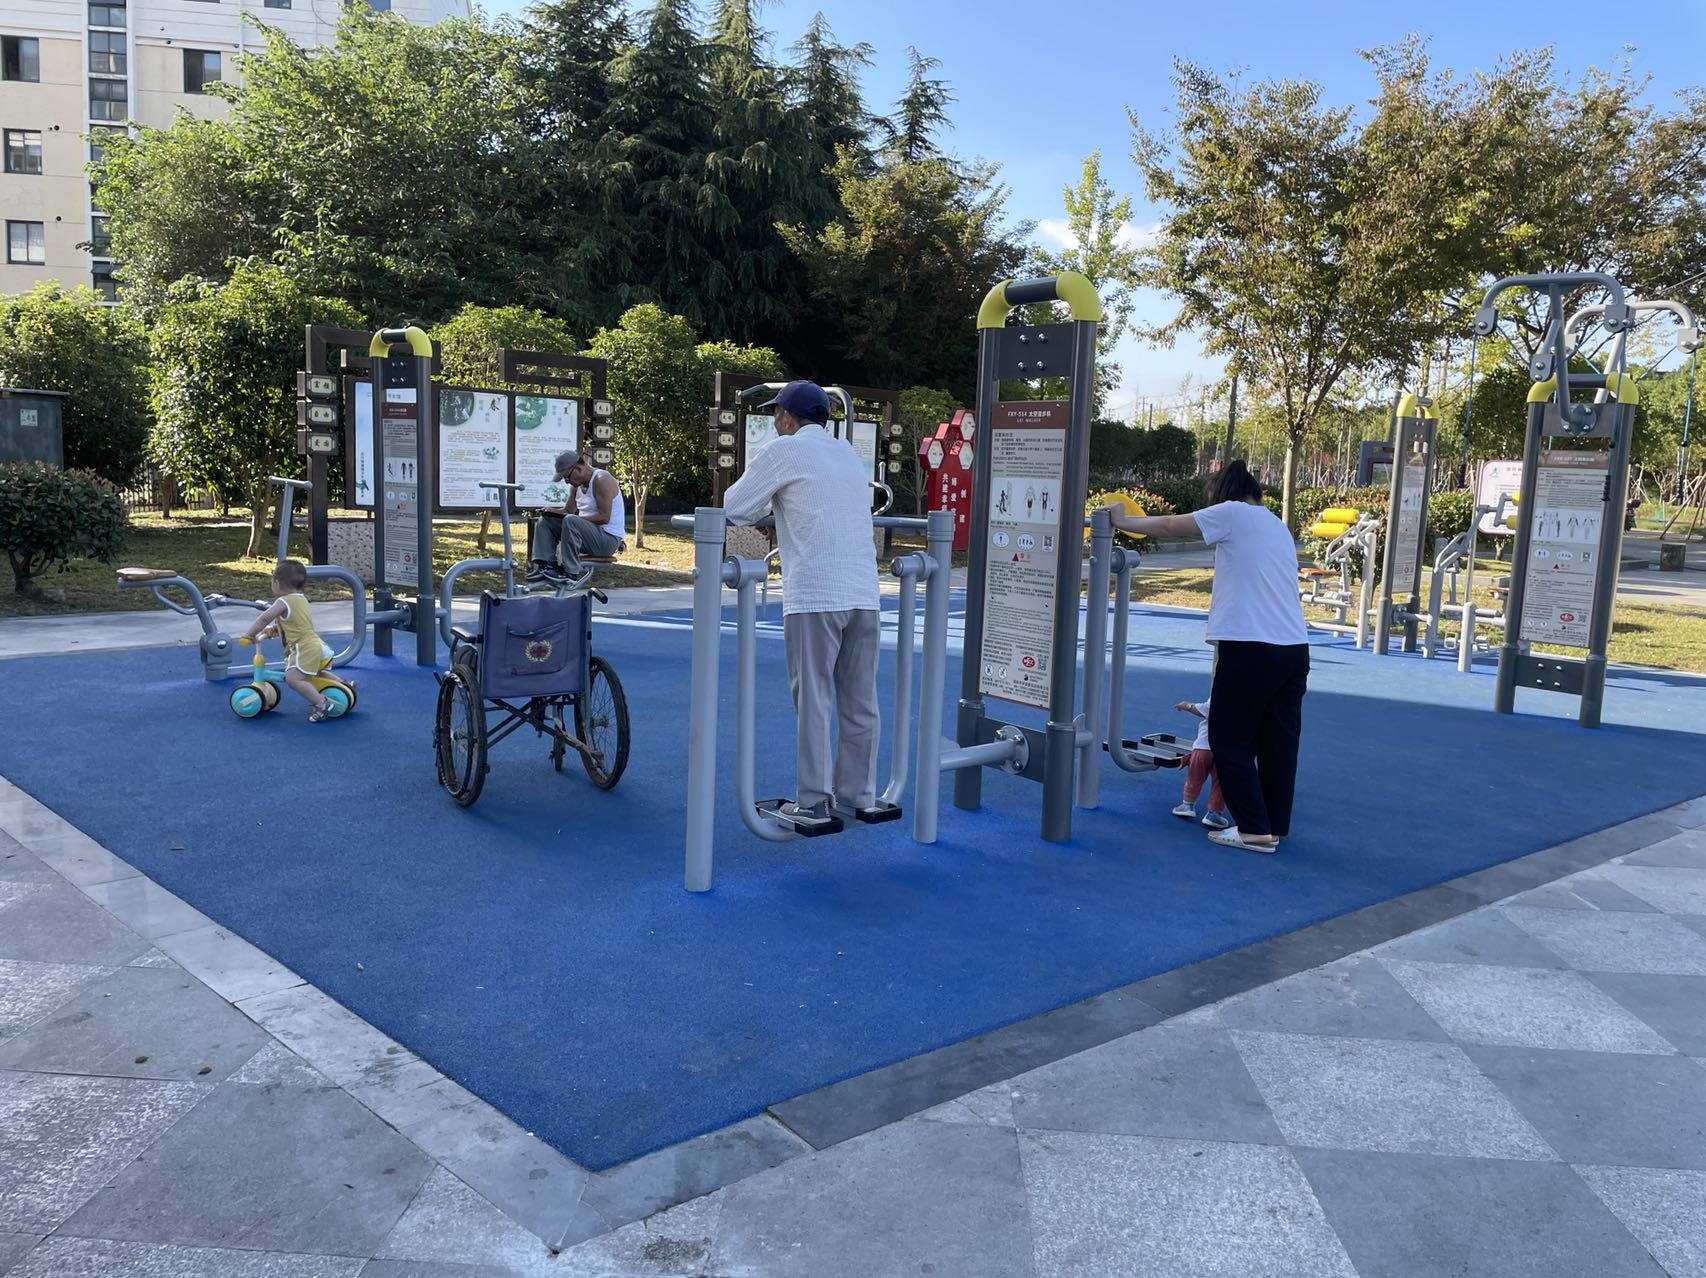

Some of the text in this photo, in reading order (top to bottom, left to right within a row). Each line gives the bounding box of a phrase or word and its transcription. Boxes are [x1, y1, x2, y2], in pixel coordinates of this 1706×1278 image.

[313, 380, 330, 390] 富强
[488, 398, 500, 411] 春
[314, 410, 330, 419] 自由
